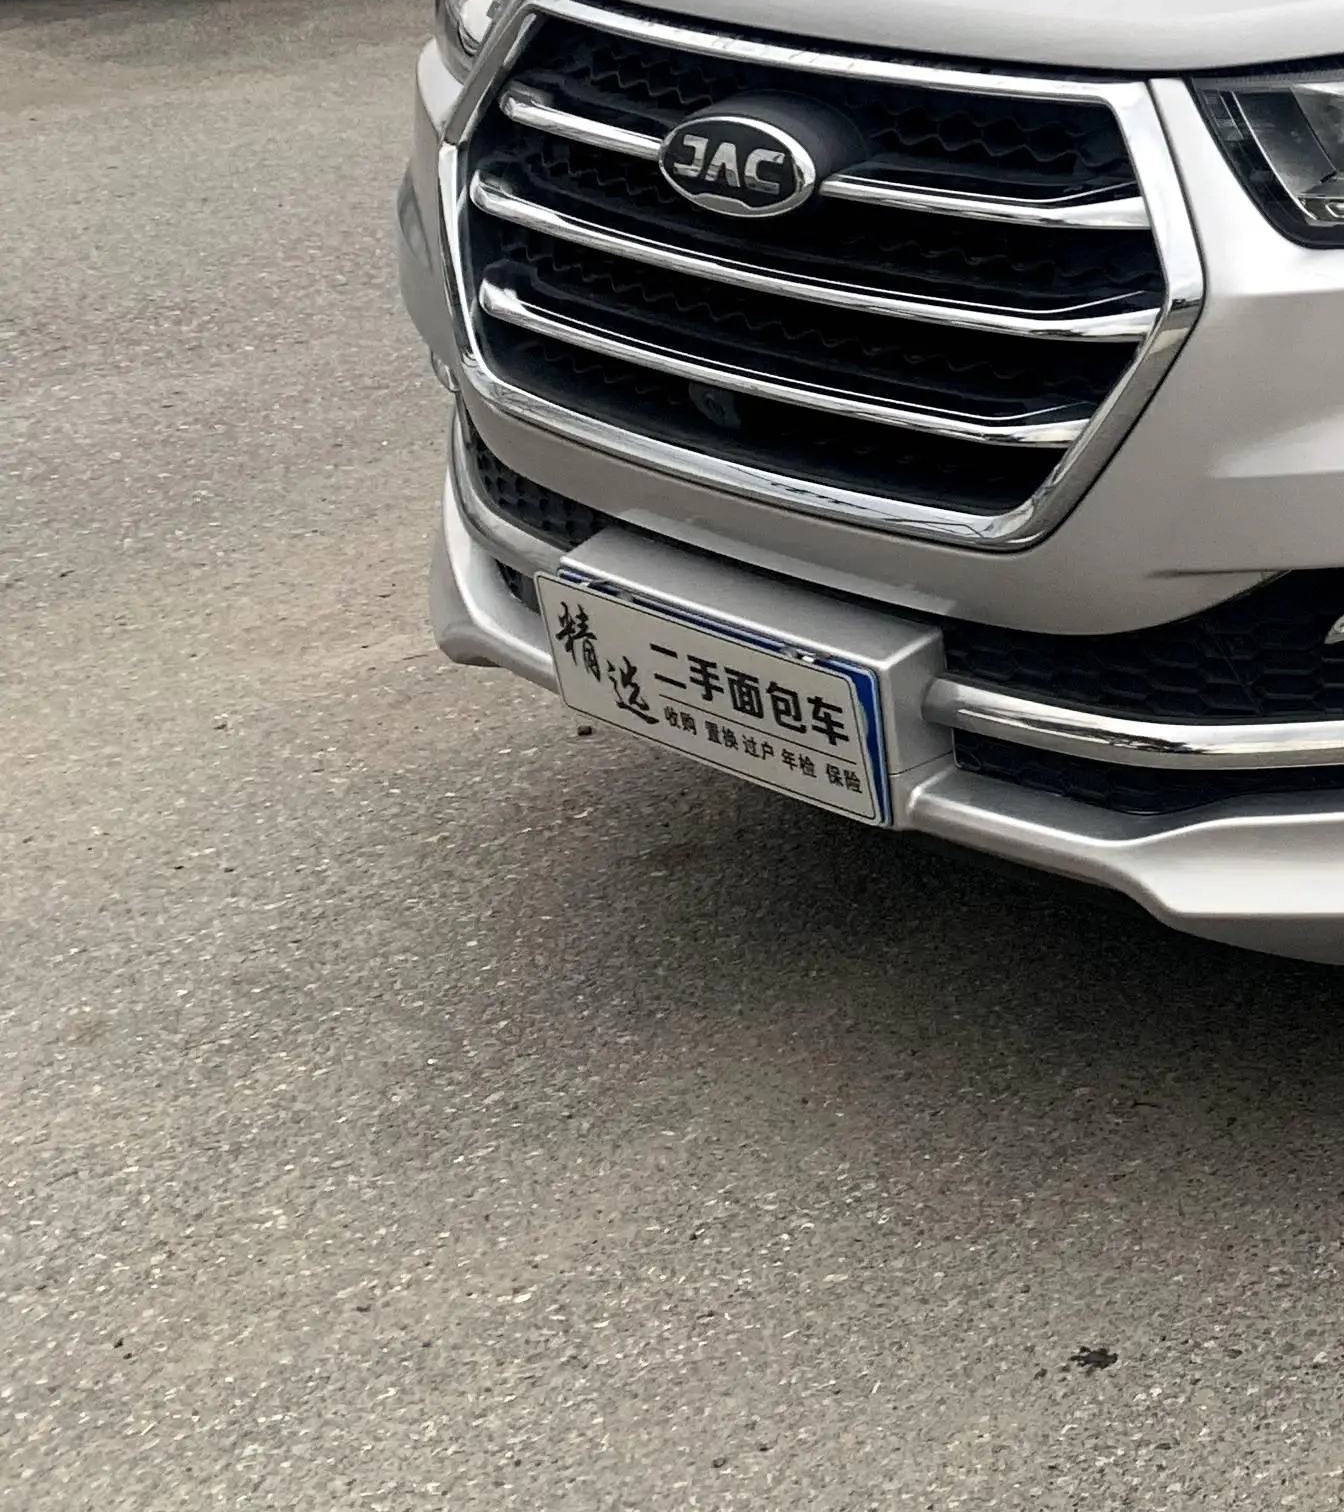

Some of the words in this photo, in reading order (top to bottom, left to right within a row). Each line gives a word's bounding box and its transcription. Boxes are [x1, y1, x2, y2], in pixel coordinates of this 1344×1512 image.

[673, 134, 785, 195] JAC
[650, 643, 849, 746] 二手面包车
[664, 705, 697, 736] 收购
[705, 720, 738, 751] 置换
[742, 734, 774, 761] 过户
[781, 748, 817, 779] 年检
[826, 763, 863, 794] 保险
